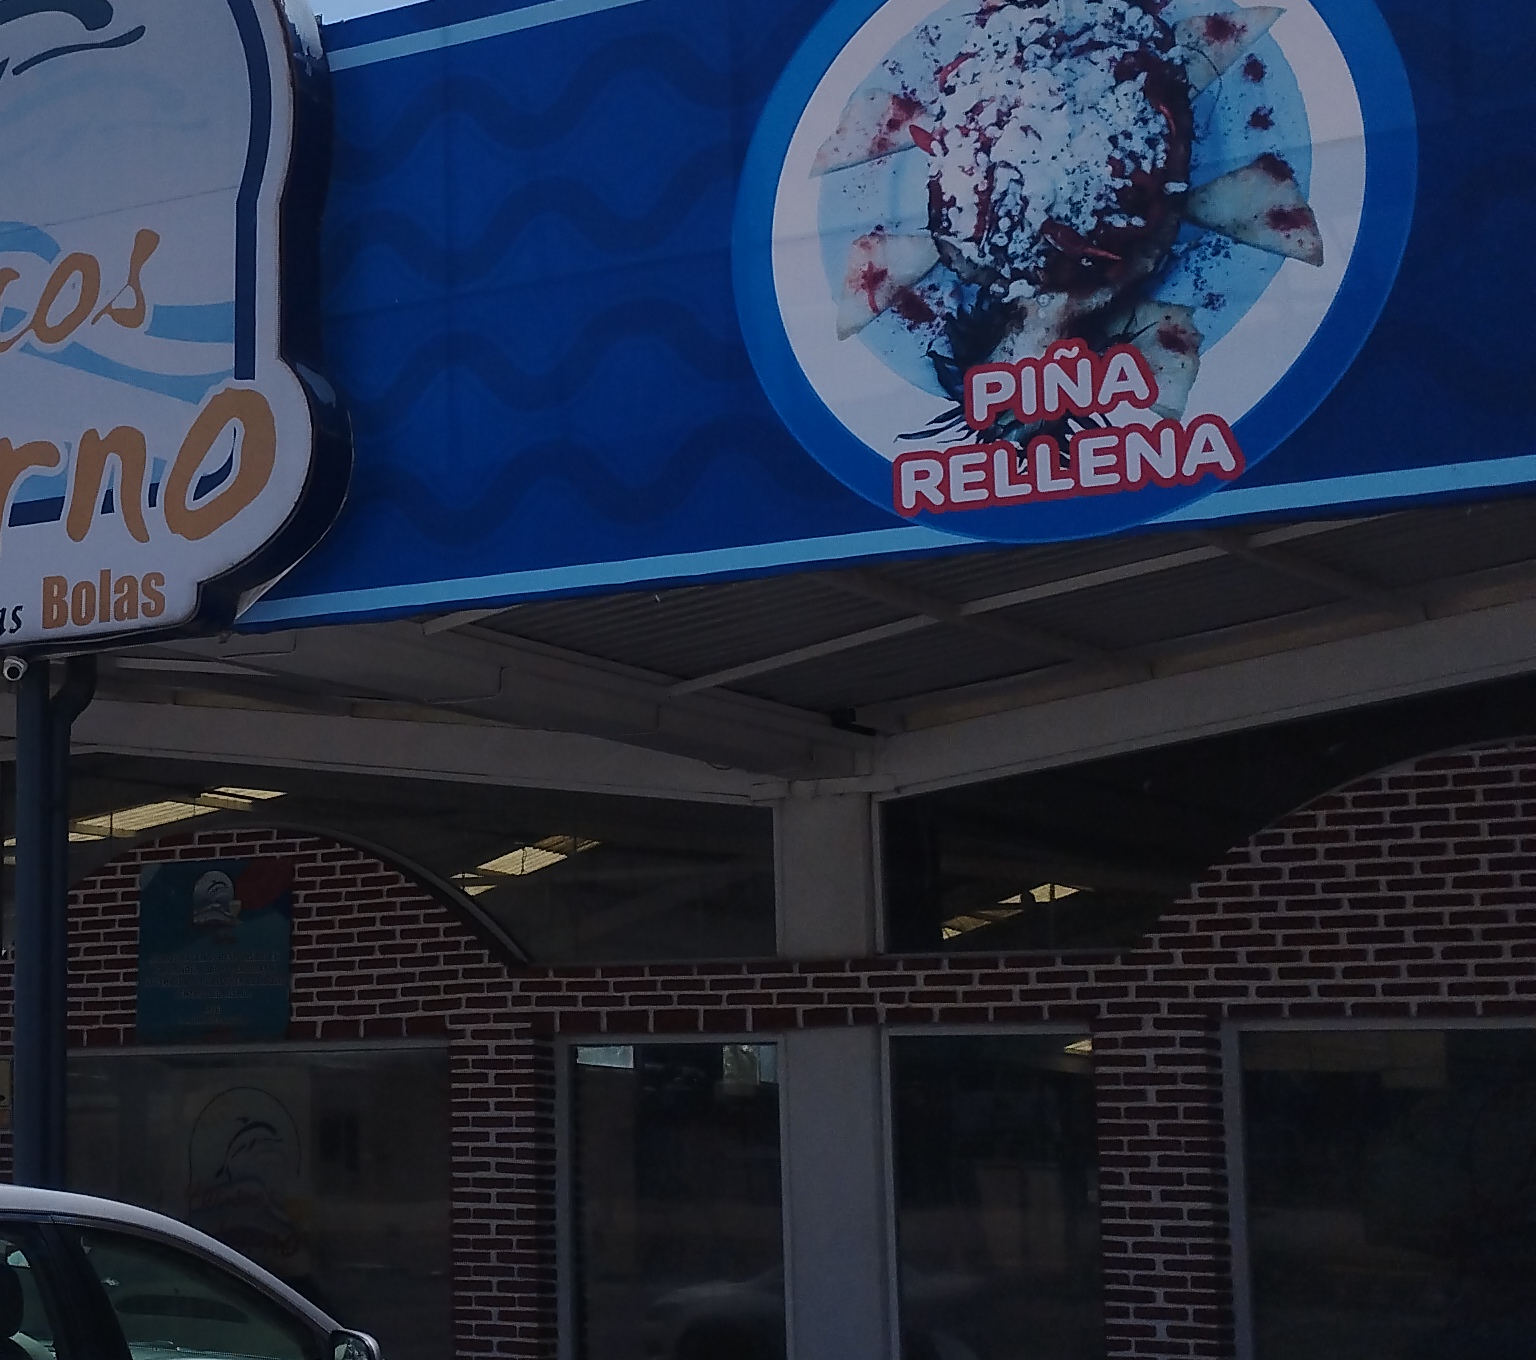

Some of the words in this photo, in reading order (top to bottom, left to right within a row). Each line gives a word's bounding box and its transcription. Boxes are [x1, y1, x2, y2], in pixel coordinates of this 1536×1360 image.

[972, 346, 1151, 423] PIÑA
[900, 422, 1236, 510] RELLENA
[42, 568, 167, 630] Bolas
